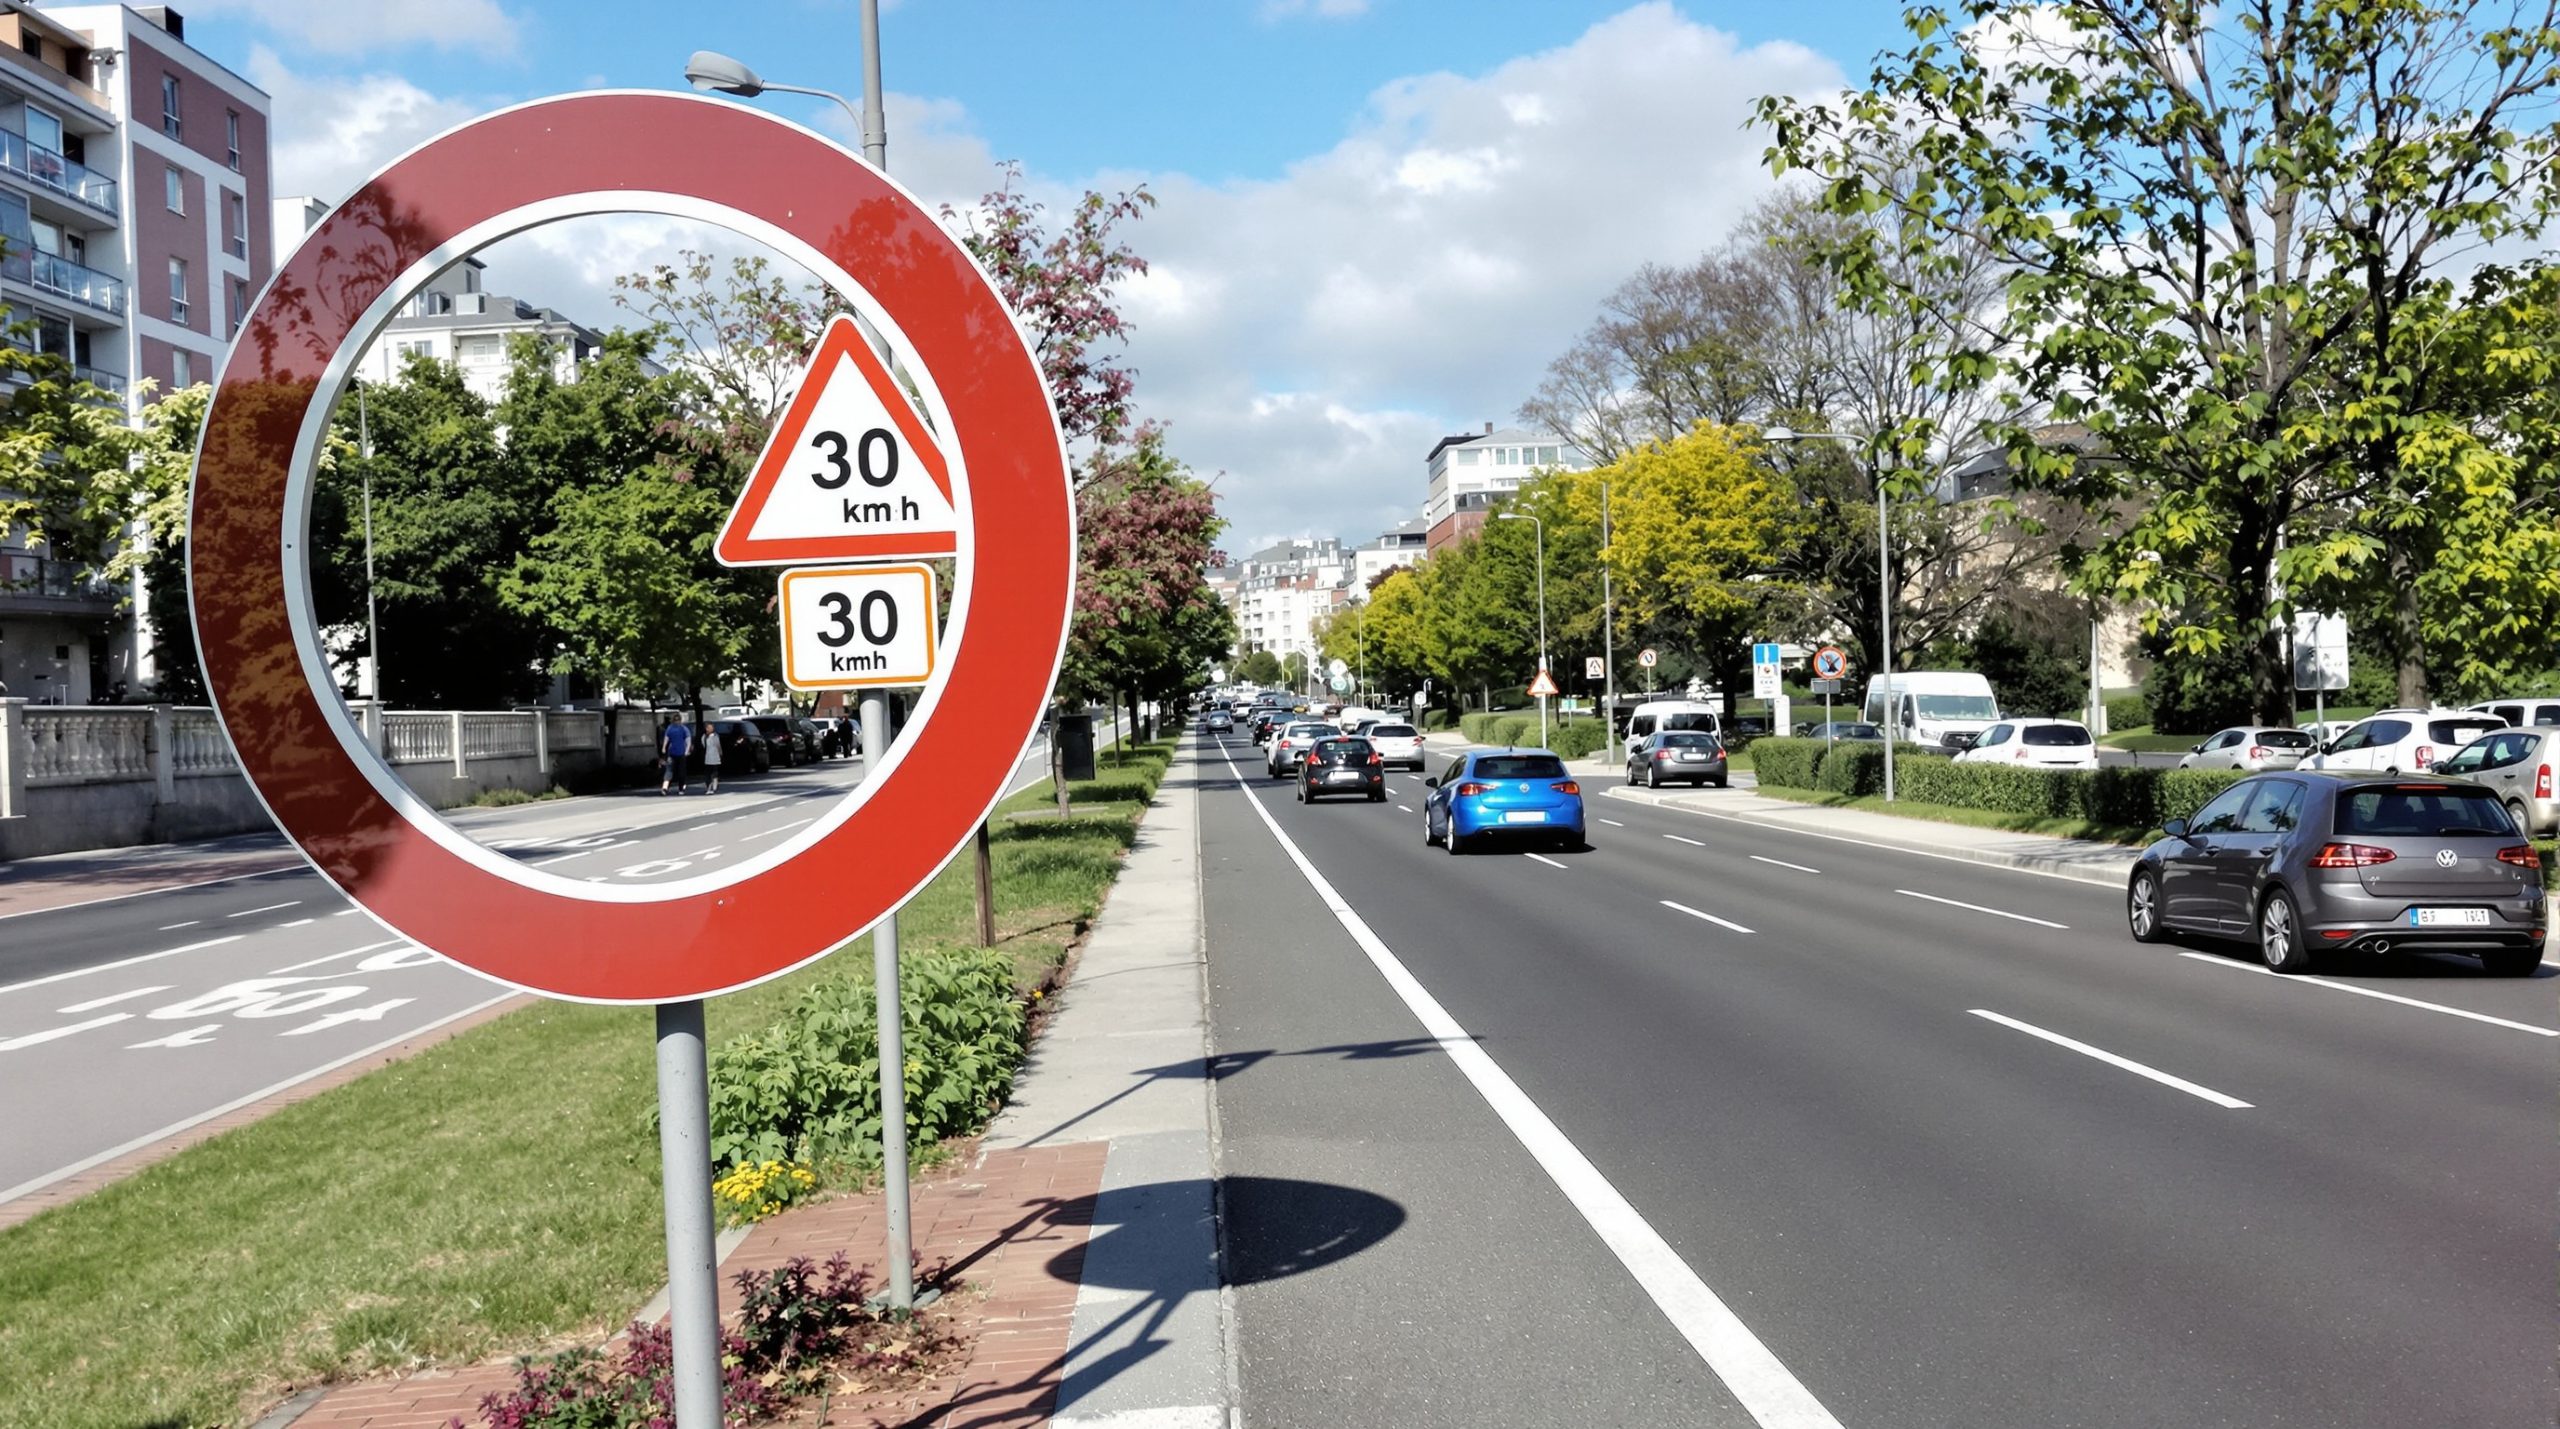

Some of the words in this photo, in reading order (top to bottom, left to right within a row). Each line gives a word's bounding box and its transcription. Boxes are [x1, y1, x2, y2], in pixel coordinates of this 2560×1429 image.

[811, 428, 899, 490] 30
[817, 589, 898, 648] 30
[831, 650, 887, 672] kmh
